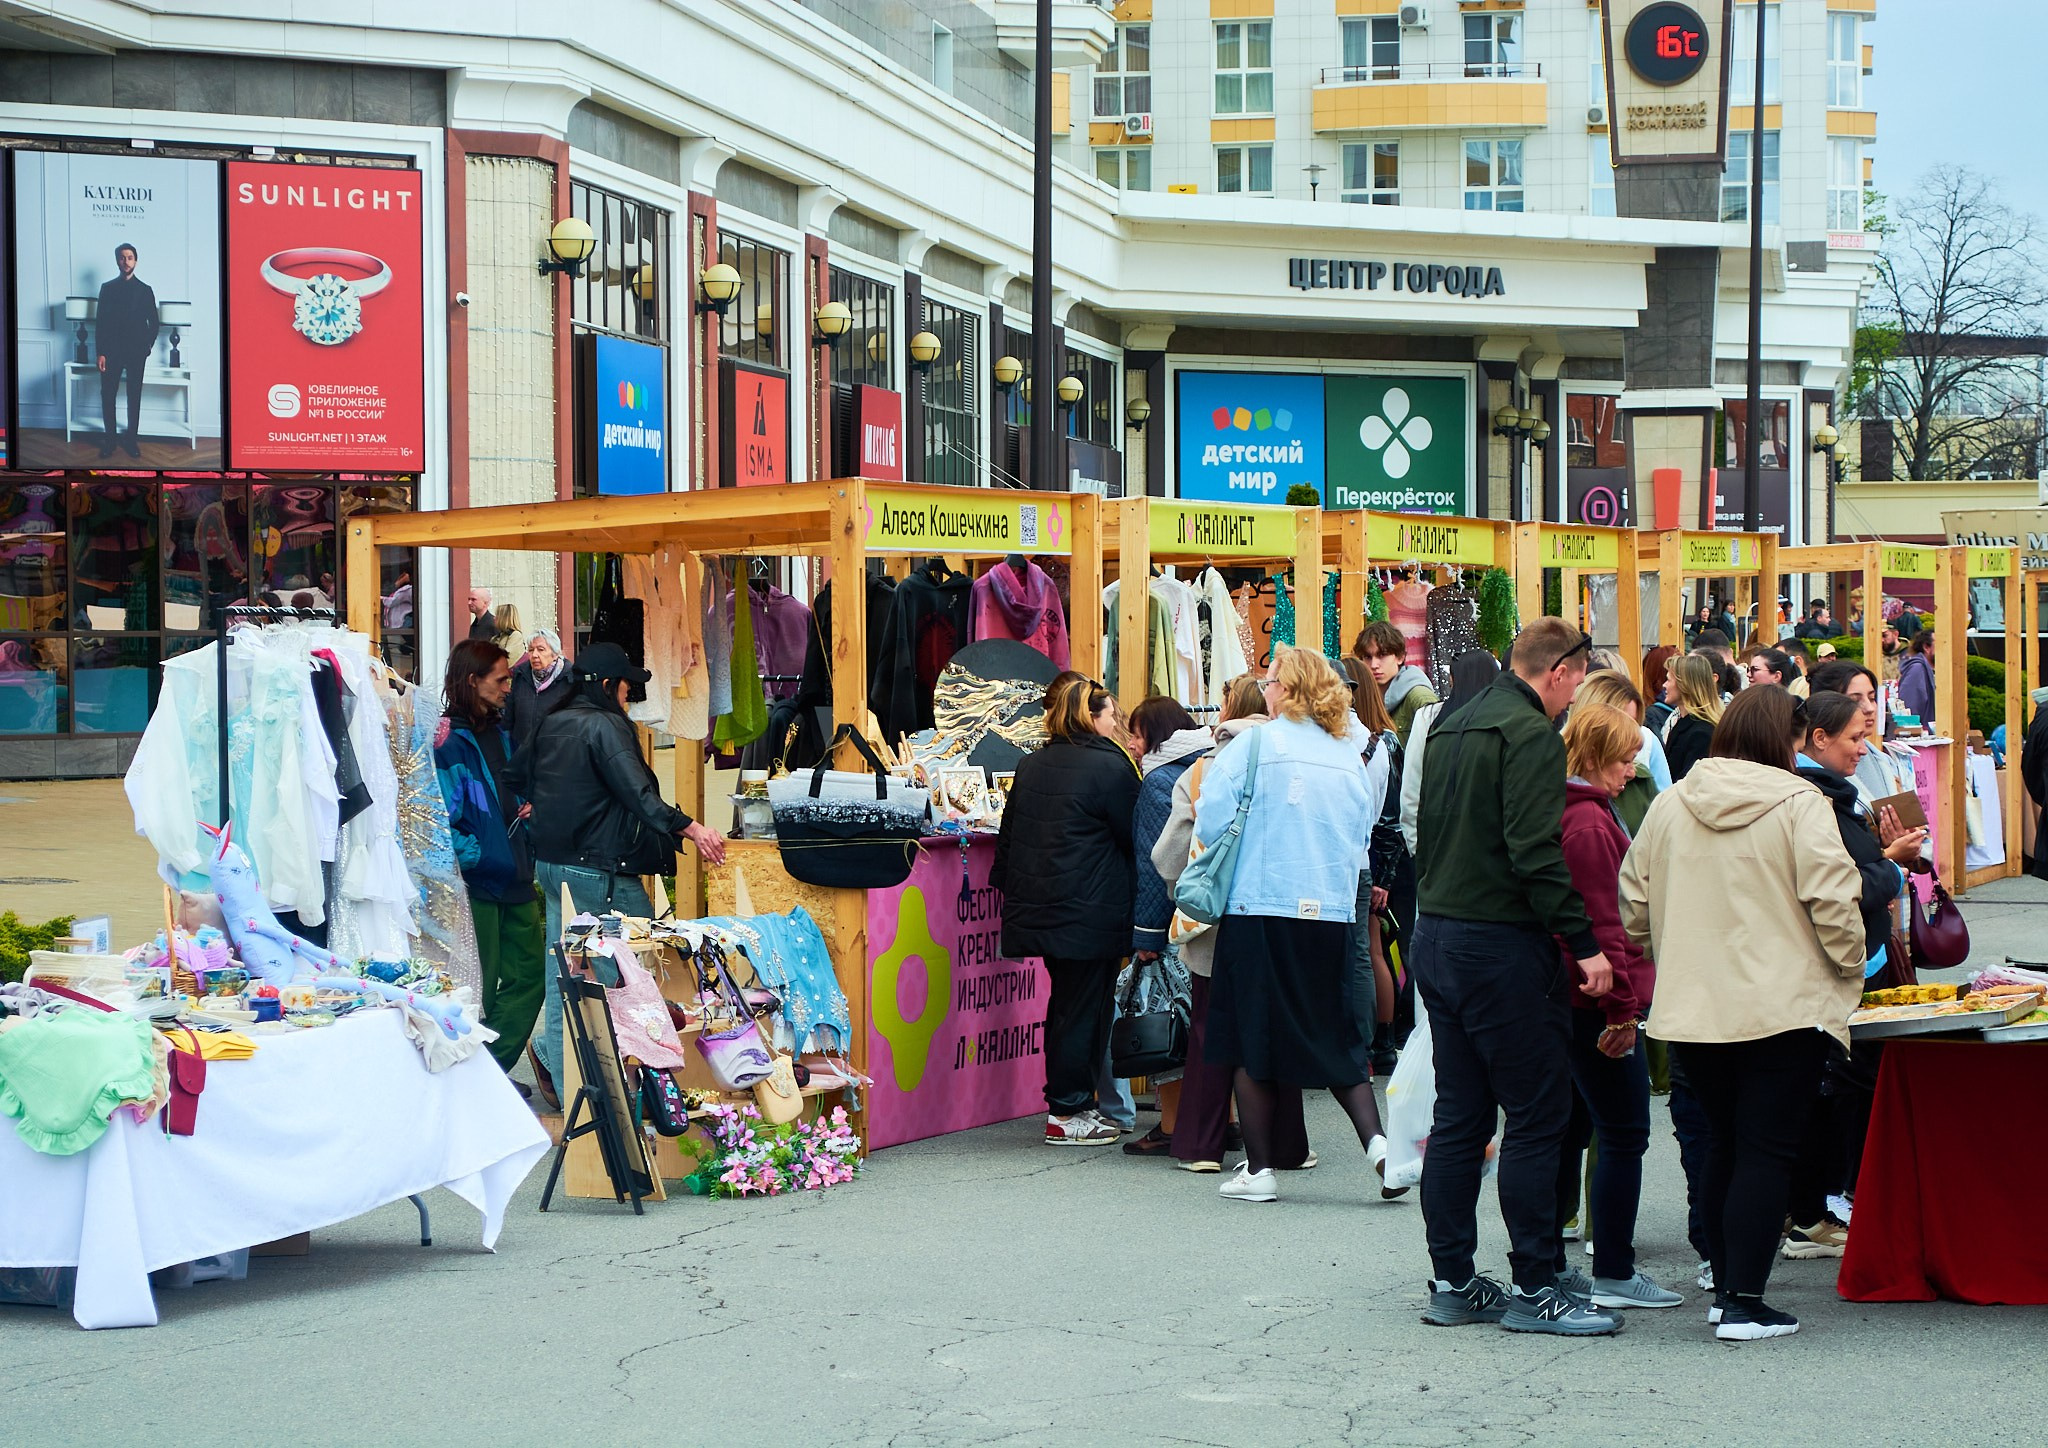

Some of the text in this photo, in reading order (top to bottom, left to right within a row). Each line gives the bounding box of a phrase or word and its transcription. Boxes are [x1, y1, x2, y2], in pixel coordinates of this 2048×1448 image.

[1627, 100, 1707, 118] ТОРГОВЫЙ
[1627, 118, 1707, 131] КОМПЛЕКС
[84, 185, 152, 201] KATARDI
[238, 183, 412, 211] SUNLIGHT
[92, 203, 145, 213] INDUSTRIES
[1289, 258, 1506, 298] ЦЕНТР ГОРОДА
[308, 384, 379, 396] ЮВЕЛИРНОЕ
[308, 396, 387, 408] ПРИЛОЖЕНИЕ
[327, 409, 334, 419] В
[268, 432, 343, 443] SUNLIGHT.NET
[350, 433, 387, 443] 1 ЭТАЖ
[603, 420, 662, 458] детский мир
[400, 447, 414, 457] 16+
[745, 443, 774, 478] ISMA
[1202, 439, 1304, 466] детский
[1229, 471, 1277, 496] мир
[1336, 486, 1455, 510] Перекрёсток
[881, 502, 1009, 539] Алеся Кошечкина
[957, 887, 1004, 925] ФЕСТИ
[958, 930, 1000, 967] КРЕАТ
[957, 960, 1036, 1013] ИНДУСТРИЙ
